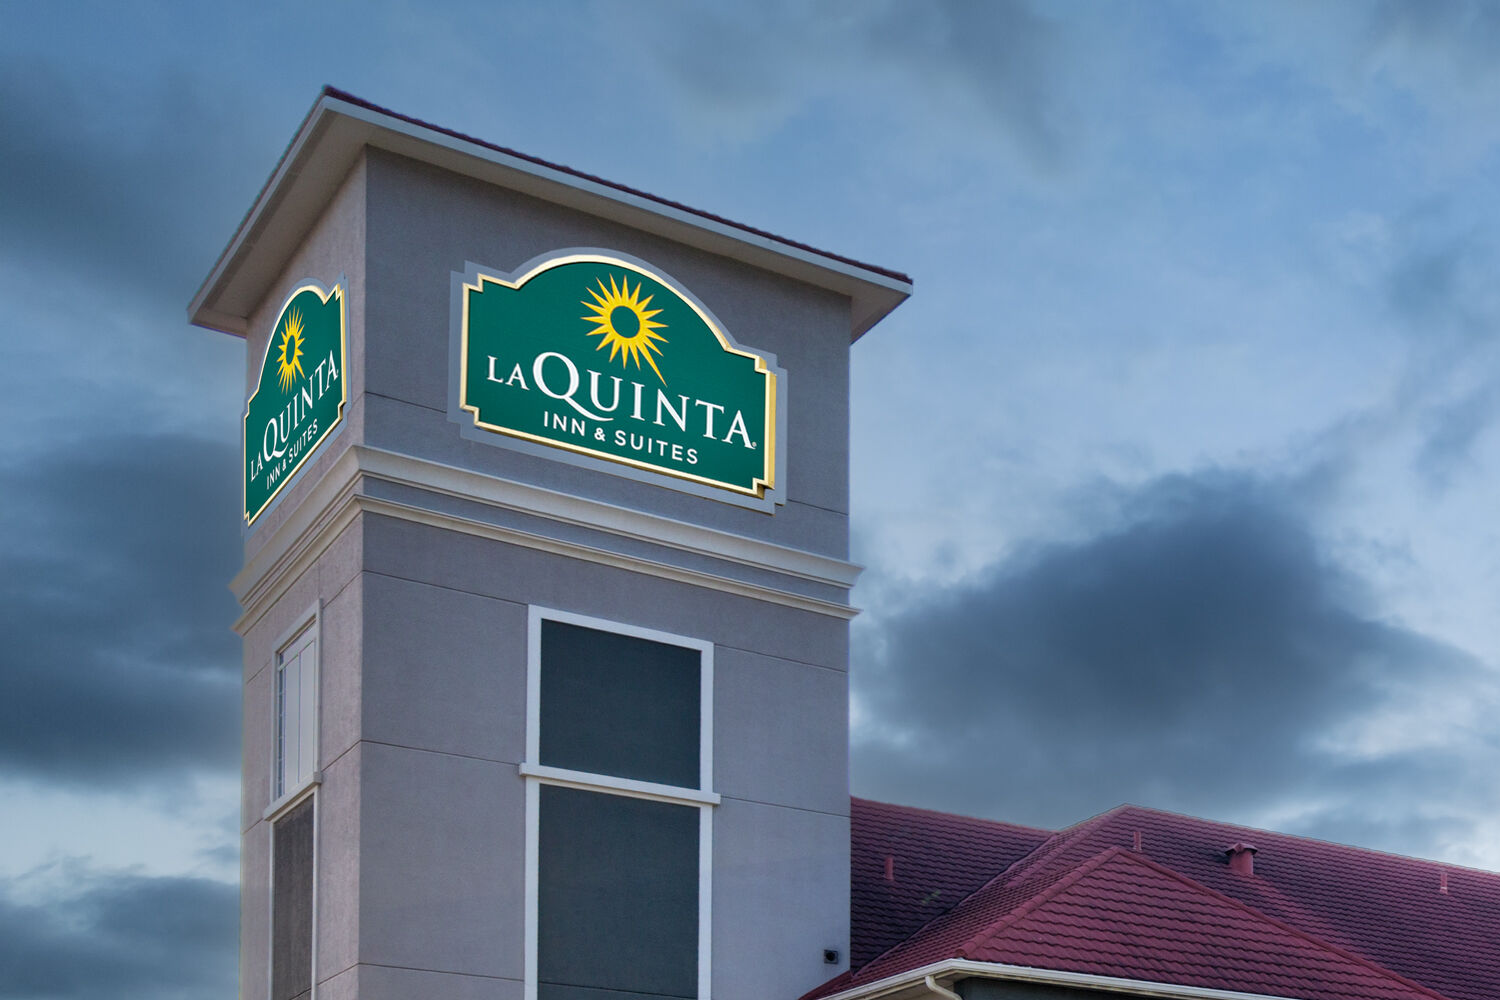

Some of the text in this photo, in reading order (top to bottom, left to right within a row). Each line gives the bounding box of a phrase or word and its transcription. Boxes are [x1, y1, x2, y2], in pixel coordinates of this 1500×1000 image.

[266, 418, 318, 490] INN & SUITES
[543, 410, 699, 464] INN & SUITES
